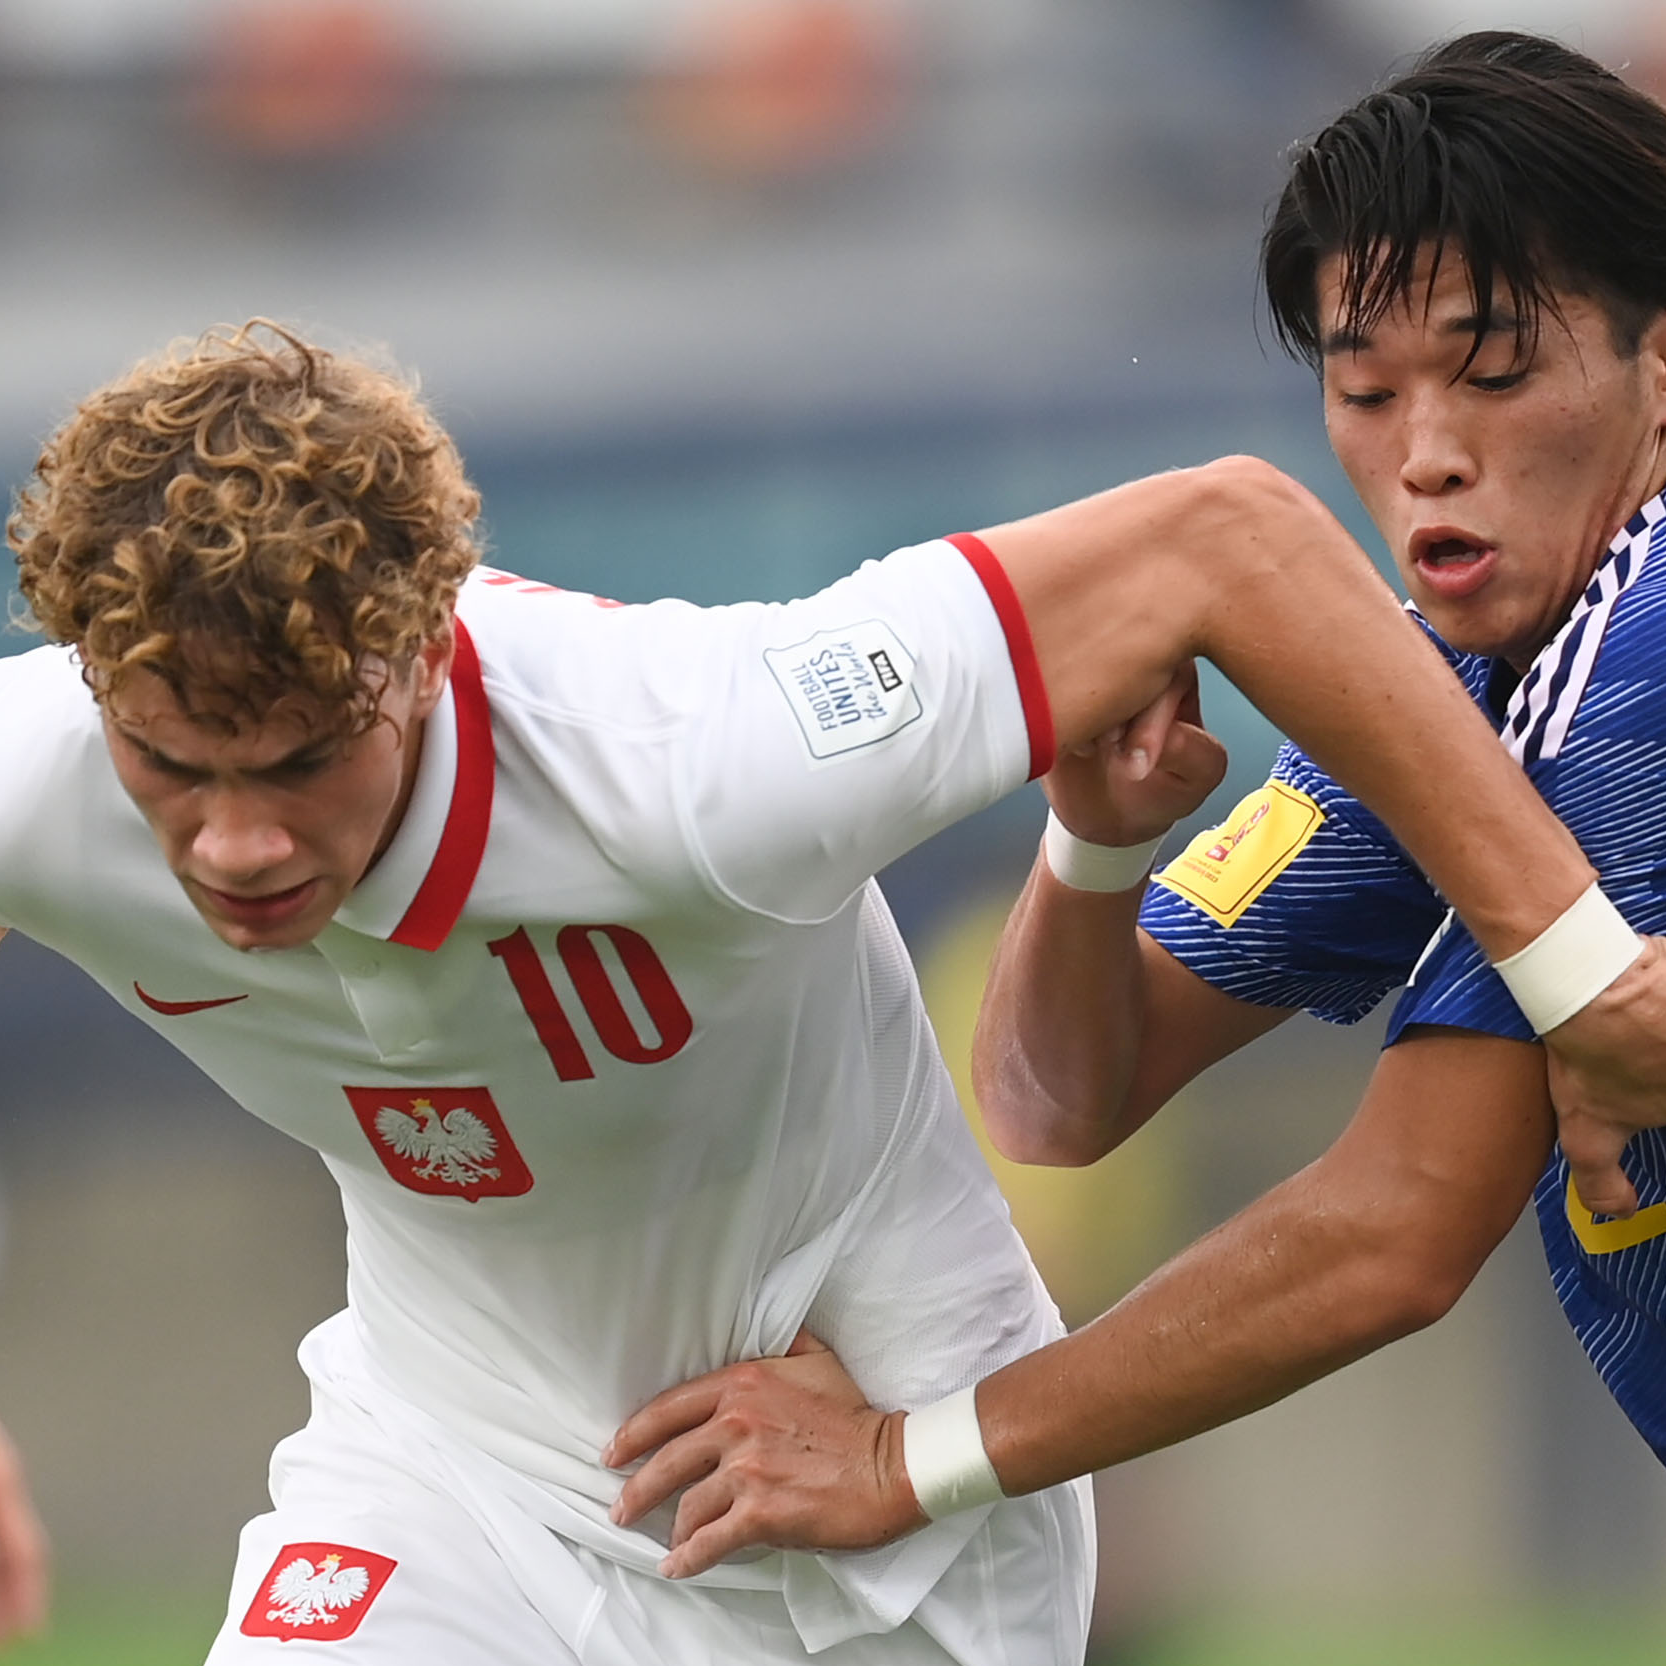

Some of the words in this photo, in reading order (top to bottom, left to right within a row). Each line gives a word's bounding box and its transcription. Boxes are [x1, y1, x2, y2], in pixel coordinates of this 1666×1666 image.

[790, 662, 837, 731] FOOTBALL
[809, 649, 862, 725] UNITES
[834, 640, 874, 691] World
[861, 689, 888, 724] the
[486, 923, 694, 1082] 10
